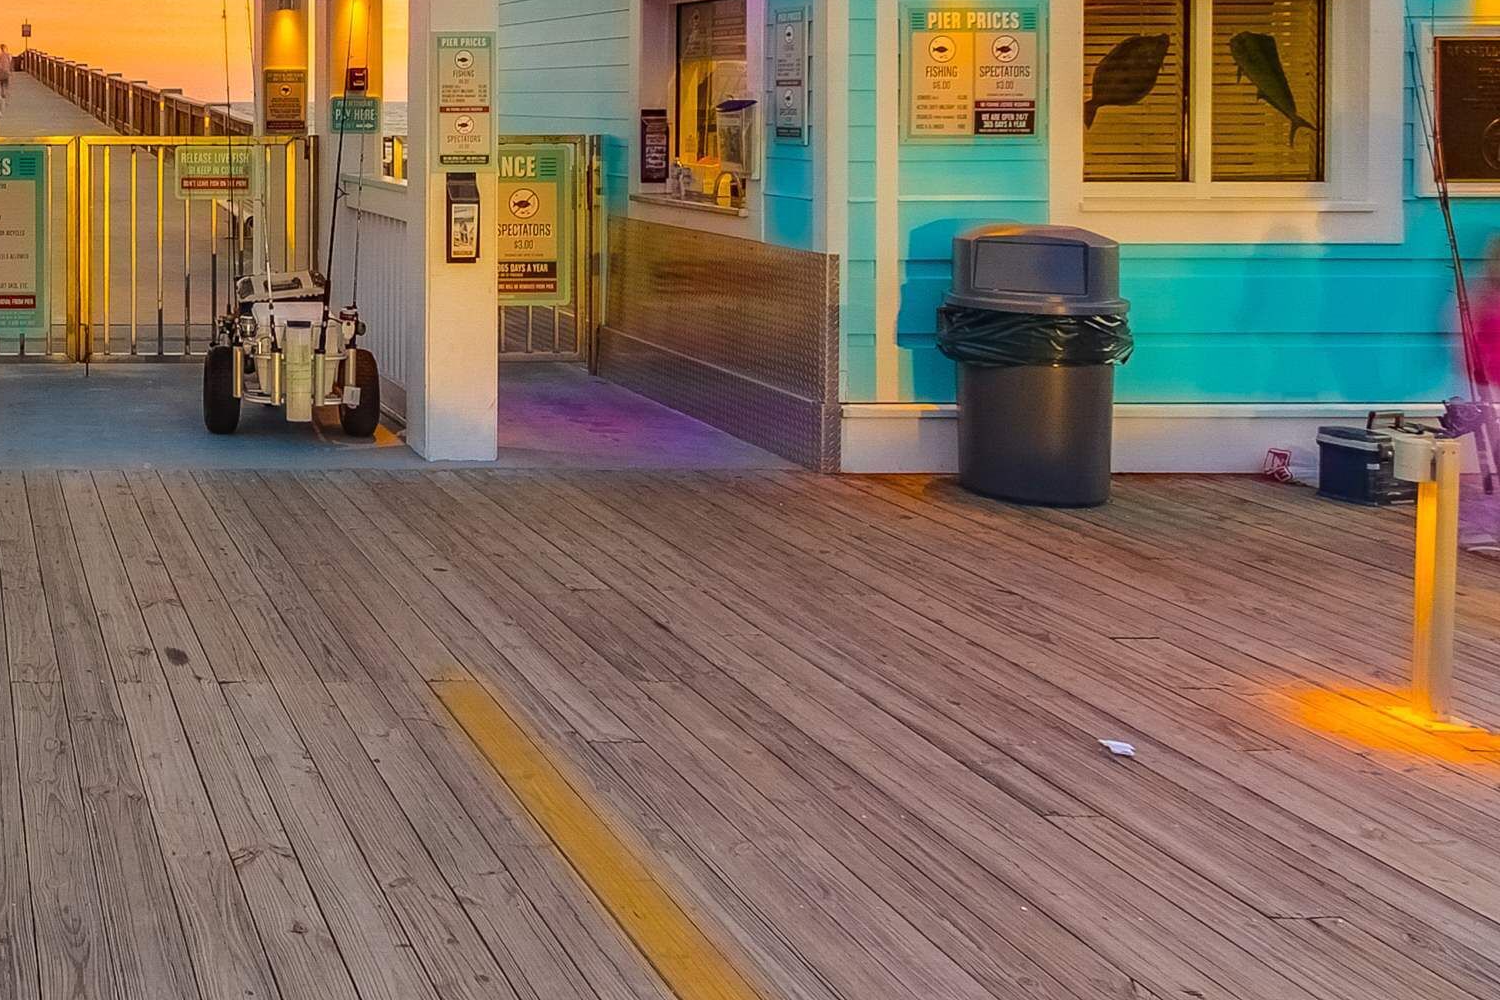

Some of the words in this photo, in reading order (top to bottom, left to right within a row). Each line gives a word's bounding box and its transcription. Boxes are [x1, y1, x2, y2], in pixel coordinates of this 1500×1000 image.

[928, 12, 961, 29] PIER
[967, 12, 1020, 29] PRICES
[442, 38, 458, 47] PIER
[925, 66, 958, 78] FISHING
[979, 66, 1031, 78] SPECTATORS
[354, 108, 375, 120] HERE
[181, 152, 211, 163] RELEASE
[510, 264, 526, 272] DAYS
[527, 264, 532, 272] A
[533, 264, 548, 272] YEAR
